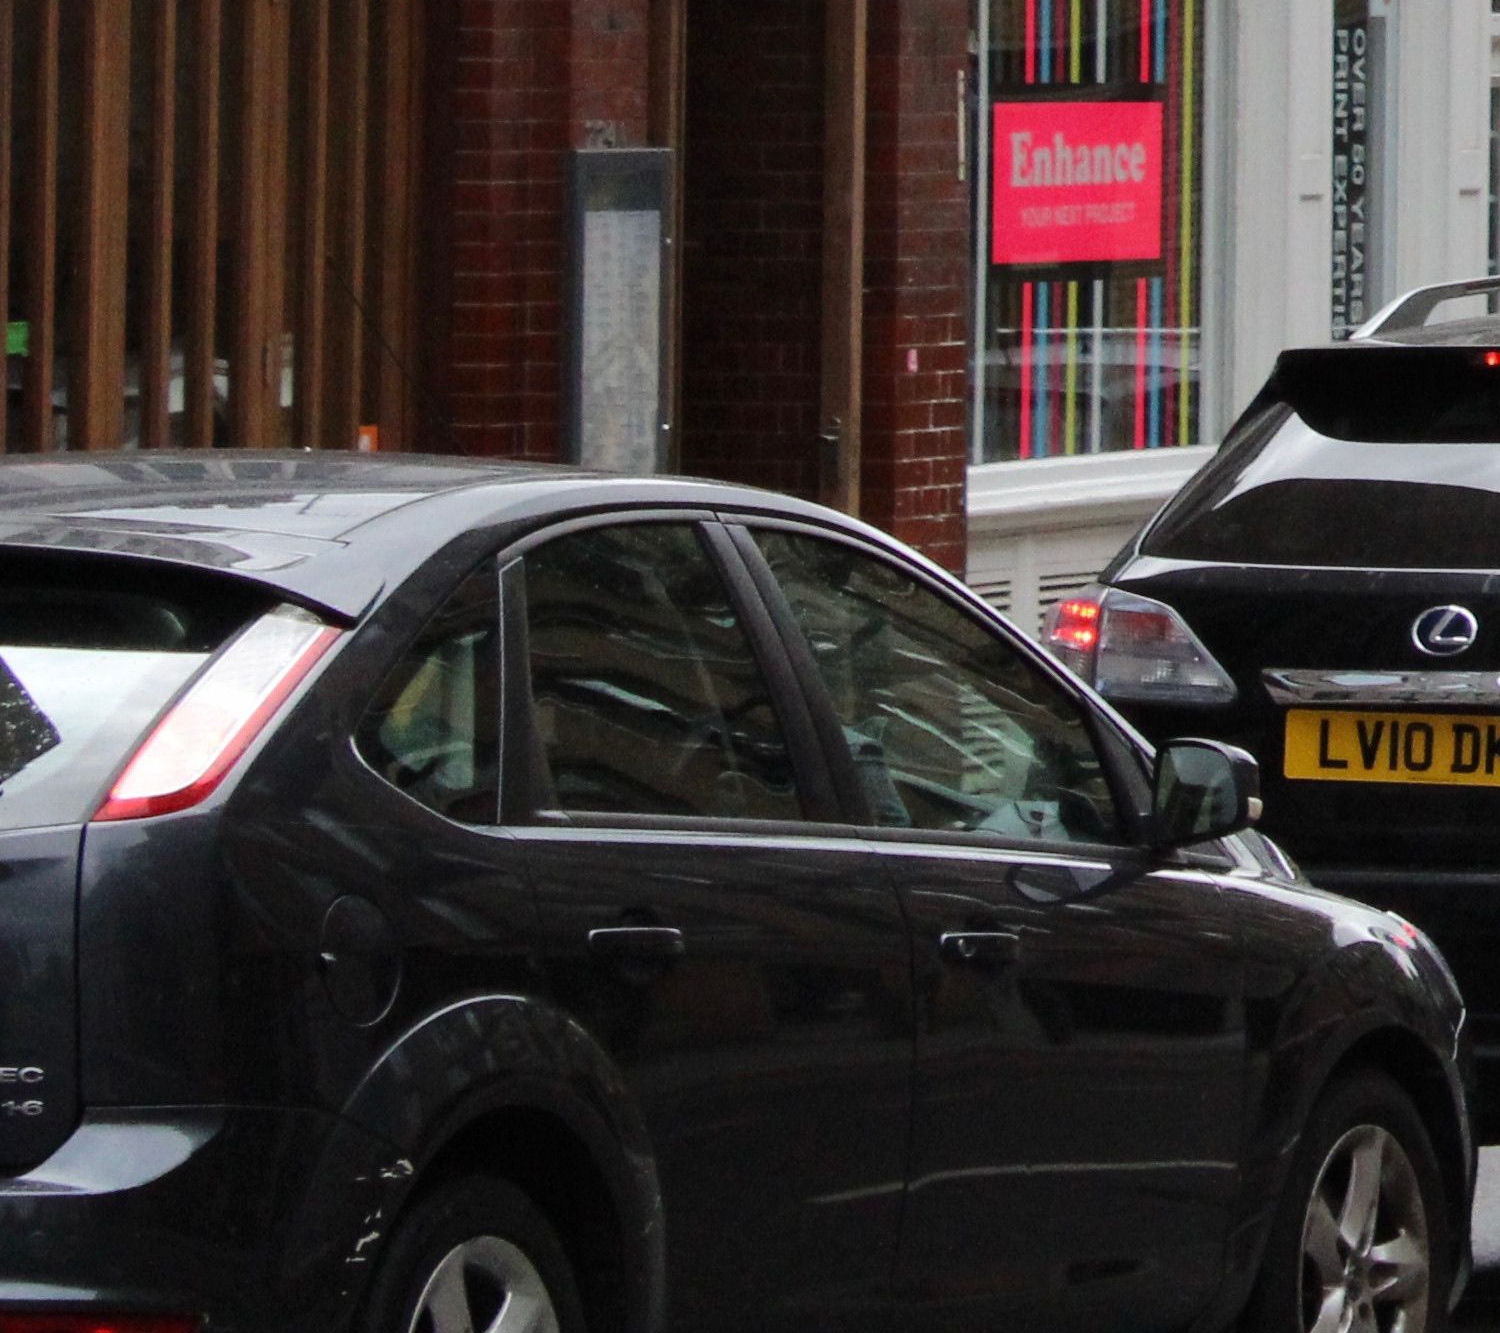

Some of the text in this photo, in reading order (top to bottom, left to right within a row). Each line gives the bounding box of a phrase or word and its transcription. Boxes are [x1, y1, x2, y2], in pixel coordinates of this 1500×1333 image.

[1352, 28, 1366, 132] OVER
[1011, 131, 1147, 188] Enhance
[1332, 29, 1349, 341] PRINT EXPERTIS
[1350, 196, 1364, 325] YEARS
[1319, 718, 1434, 771] LV10
